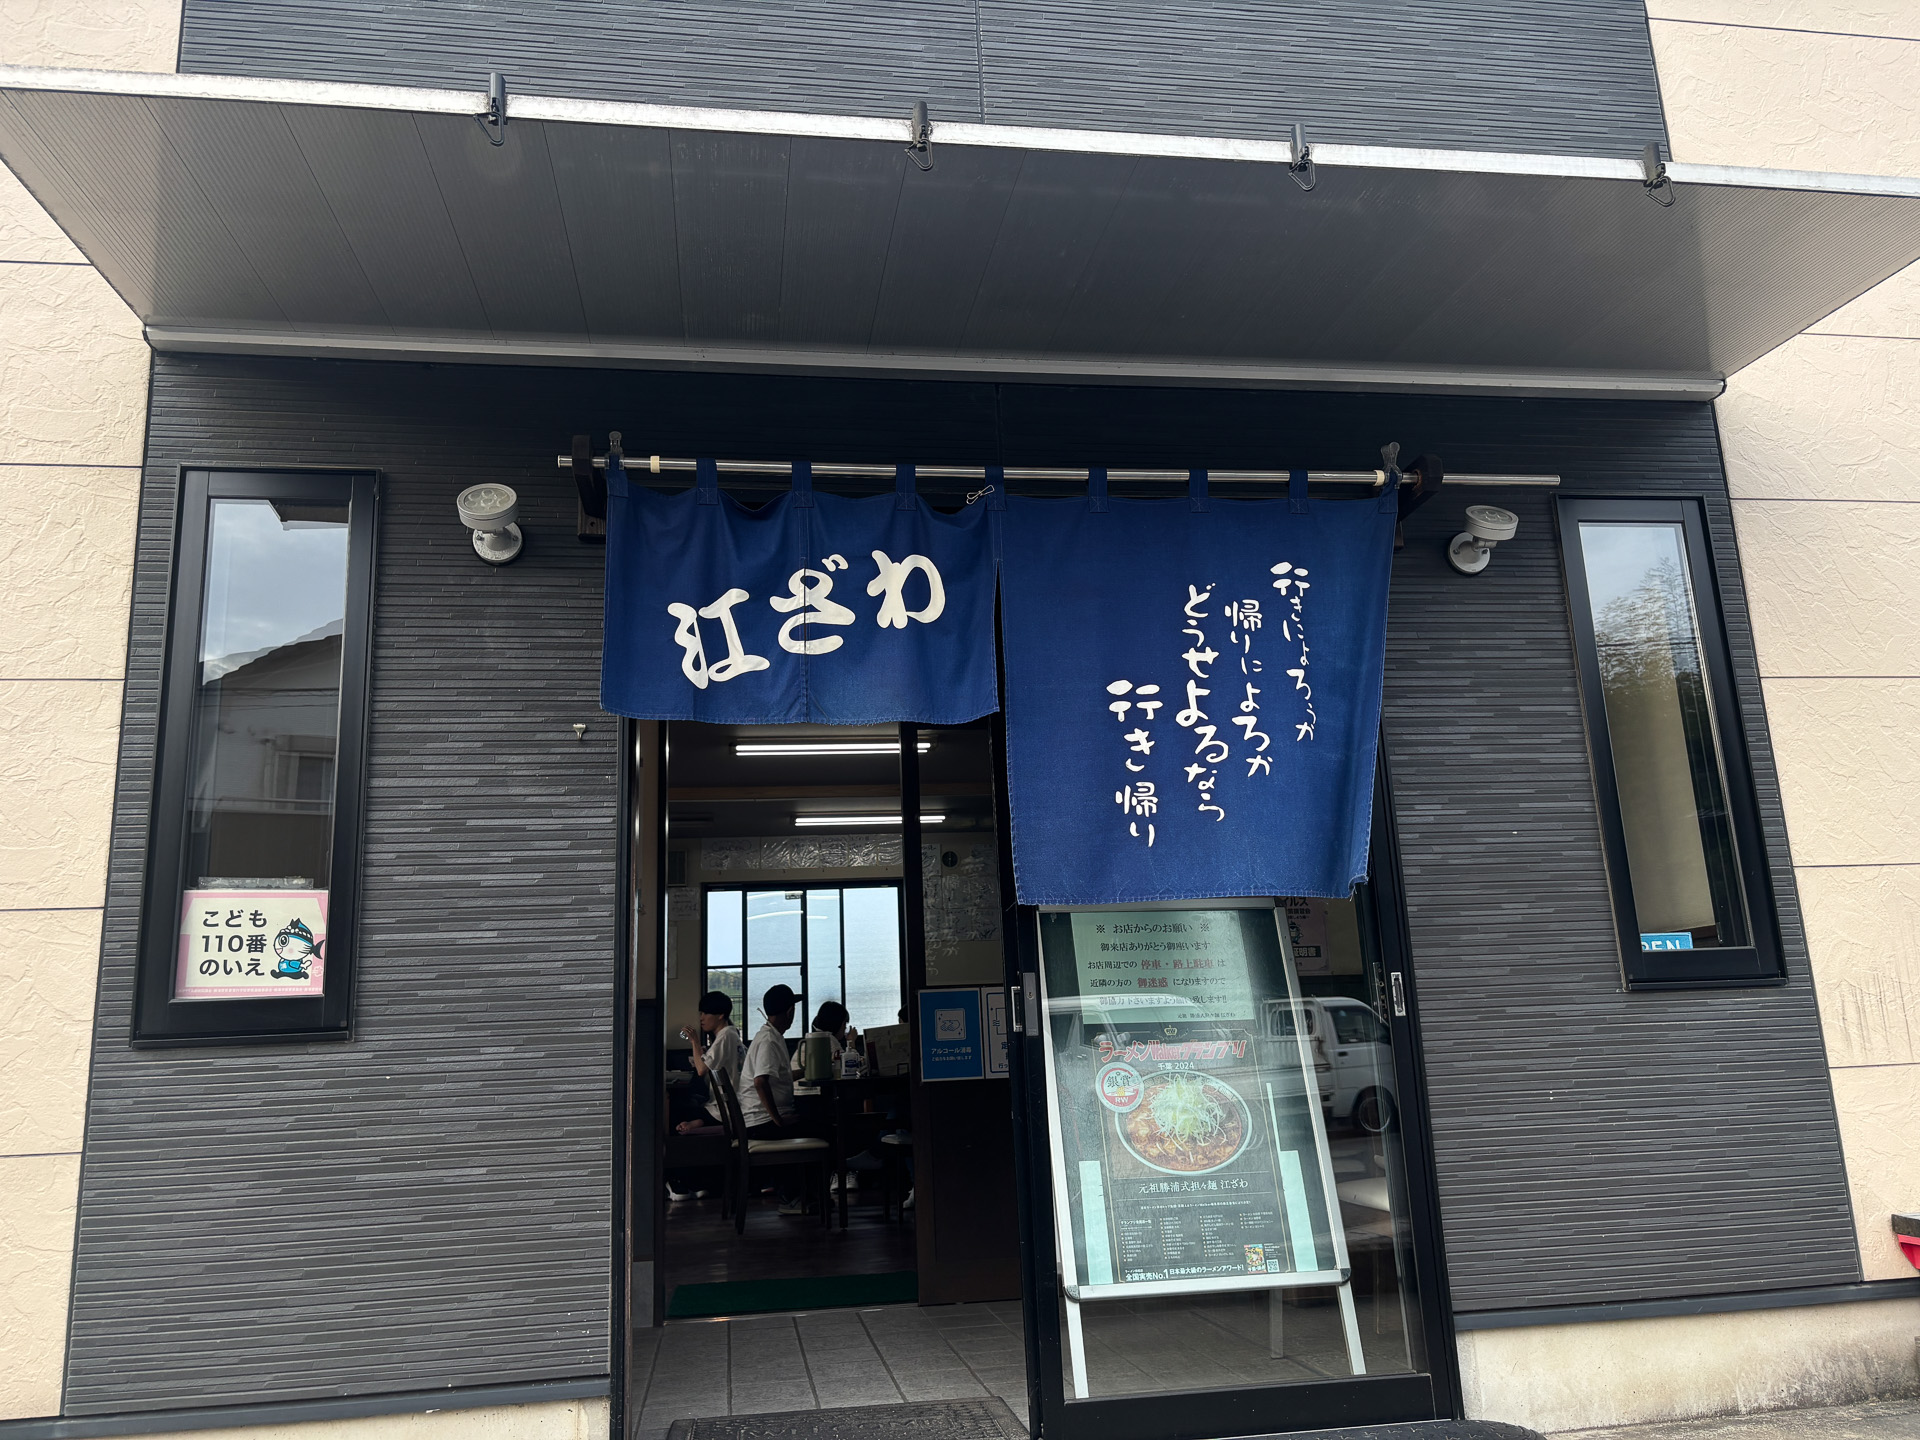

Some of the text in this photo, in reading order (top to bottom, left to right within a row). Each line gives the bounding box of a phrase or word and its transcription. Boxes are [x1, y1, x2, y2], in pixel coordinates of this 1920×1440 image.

[668, 549, 945, 690] 江ざわ
[1270, 561, 1316, 741] 行きによろうか
[1175, 582, 1229, 822] どうせよるなら
[1106, 679, 1163, 847] 行き帰り
[203, 909, 267, 928] こども
[1113, 923, 1192, 934] お店からのお願い
[201, 934, 267, 953] 110番
[1100, 941, 1210, 951] 御来店ありがとう御座います
[199, 958, 265, 976] のいえ
[1088, 960, 1138, 970] お店周辺での
[1141, 959, 1214, 969] 停車・路上駐車
[1090, 977, 1226, 988] 近隣の方の 御迷惑 になりますので
[1099, 1040, 1247, 1062] ラーメンWalkerグランプリ
[1174, 1061, 1194, 1070] 2024
[1139, 1178, 1249, 1194] 元祖勝浦式担々麺 江ざわ
